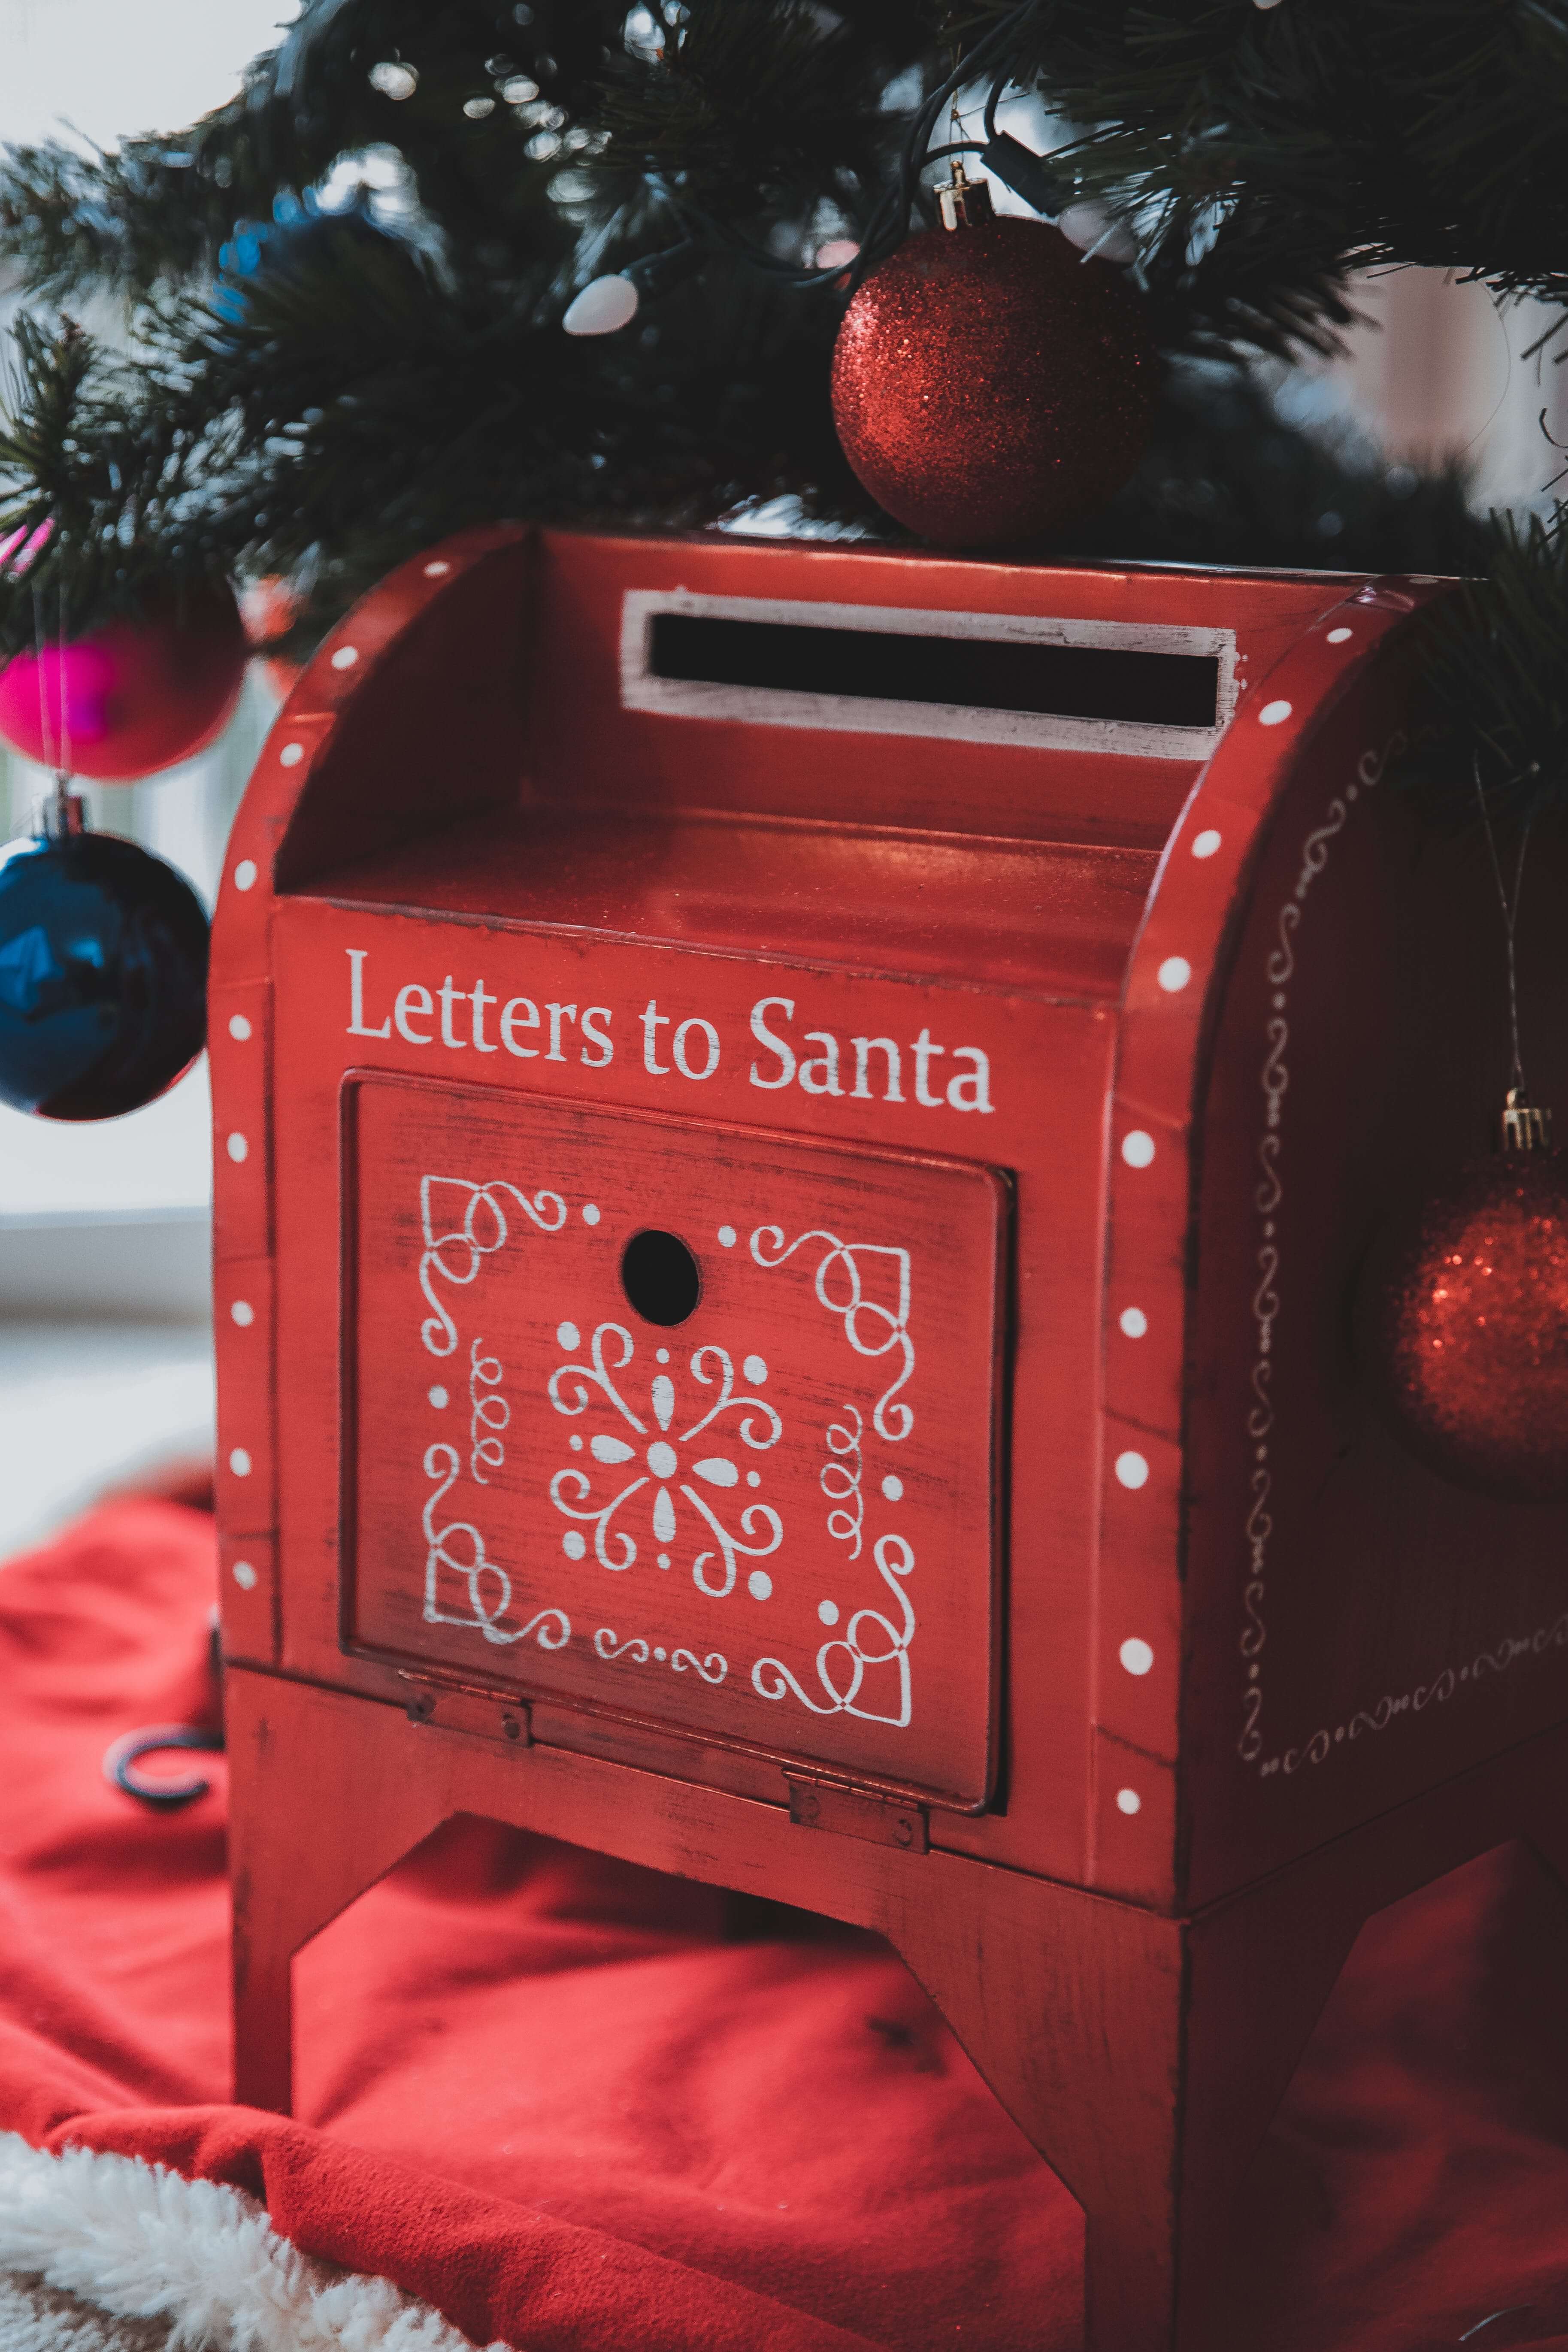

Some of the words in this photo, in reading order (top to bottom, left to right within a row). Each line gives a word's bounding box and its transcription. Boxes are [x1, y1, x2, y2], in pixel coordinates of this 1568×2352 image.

[344, 948, 614, 1068] Letters
[638, 999, 721, 1081] to
[748, 996, 996, 1114] Santa
